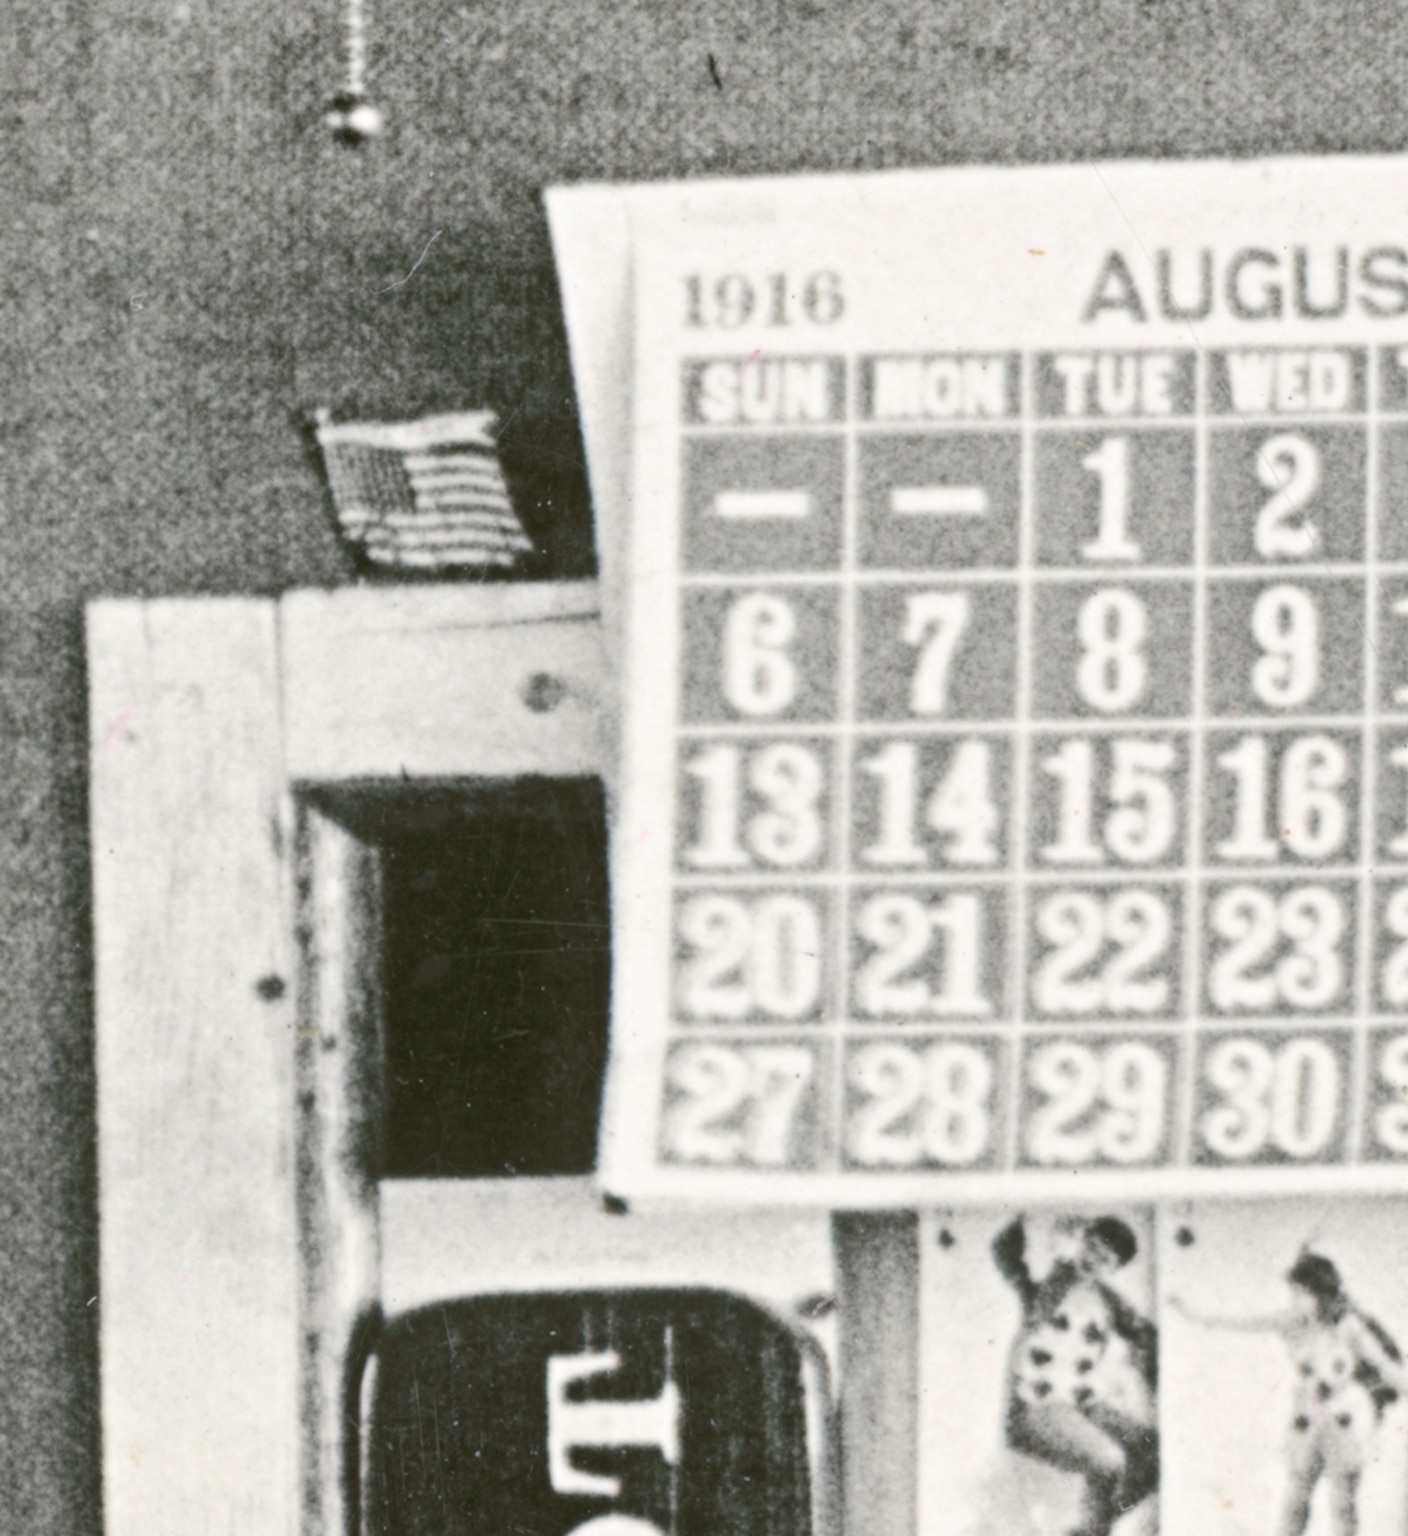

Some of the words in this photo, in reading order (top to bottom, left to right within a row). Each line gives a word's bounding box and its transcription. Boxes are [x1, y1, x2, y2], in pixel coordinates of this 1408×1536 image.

[685, 273, 845, 328] 1916
[702, 362, 828, 417] SUN
[875, 360, 1005, 415] MON
[1055, 357, 1176, 416] TUE
[1228, 355, 1350, 412] WED
[1083, 438, 1140, 558] 1
[1255, 434, 1320, 556] 2
[724, 587, 798, 717] 6
[903, 591, 970, 715] 7
[1077, 589, 1147, 711] 8
[1252, 585, 1320, 708] 9
[687, 744, 822, 865] 13
[864, 739, 997, 862] 14
[1043, 739, 1175, 861] 15
[1217, 736, 1346, 858] 16
[678, 895, 821, 1017] 20
[854, 894, 991, 1016] 21
[1034, 890, 1170, 1012] 22
[1210, 886, 1344, 1008] 23
[672, 1044, 813, 1164] 27
[852, 1044, 991, 1162] 28
[1027, 1042, 1165, 1160] 29
[1199, 1039, 1339, 1158] 30
